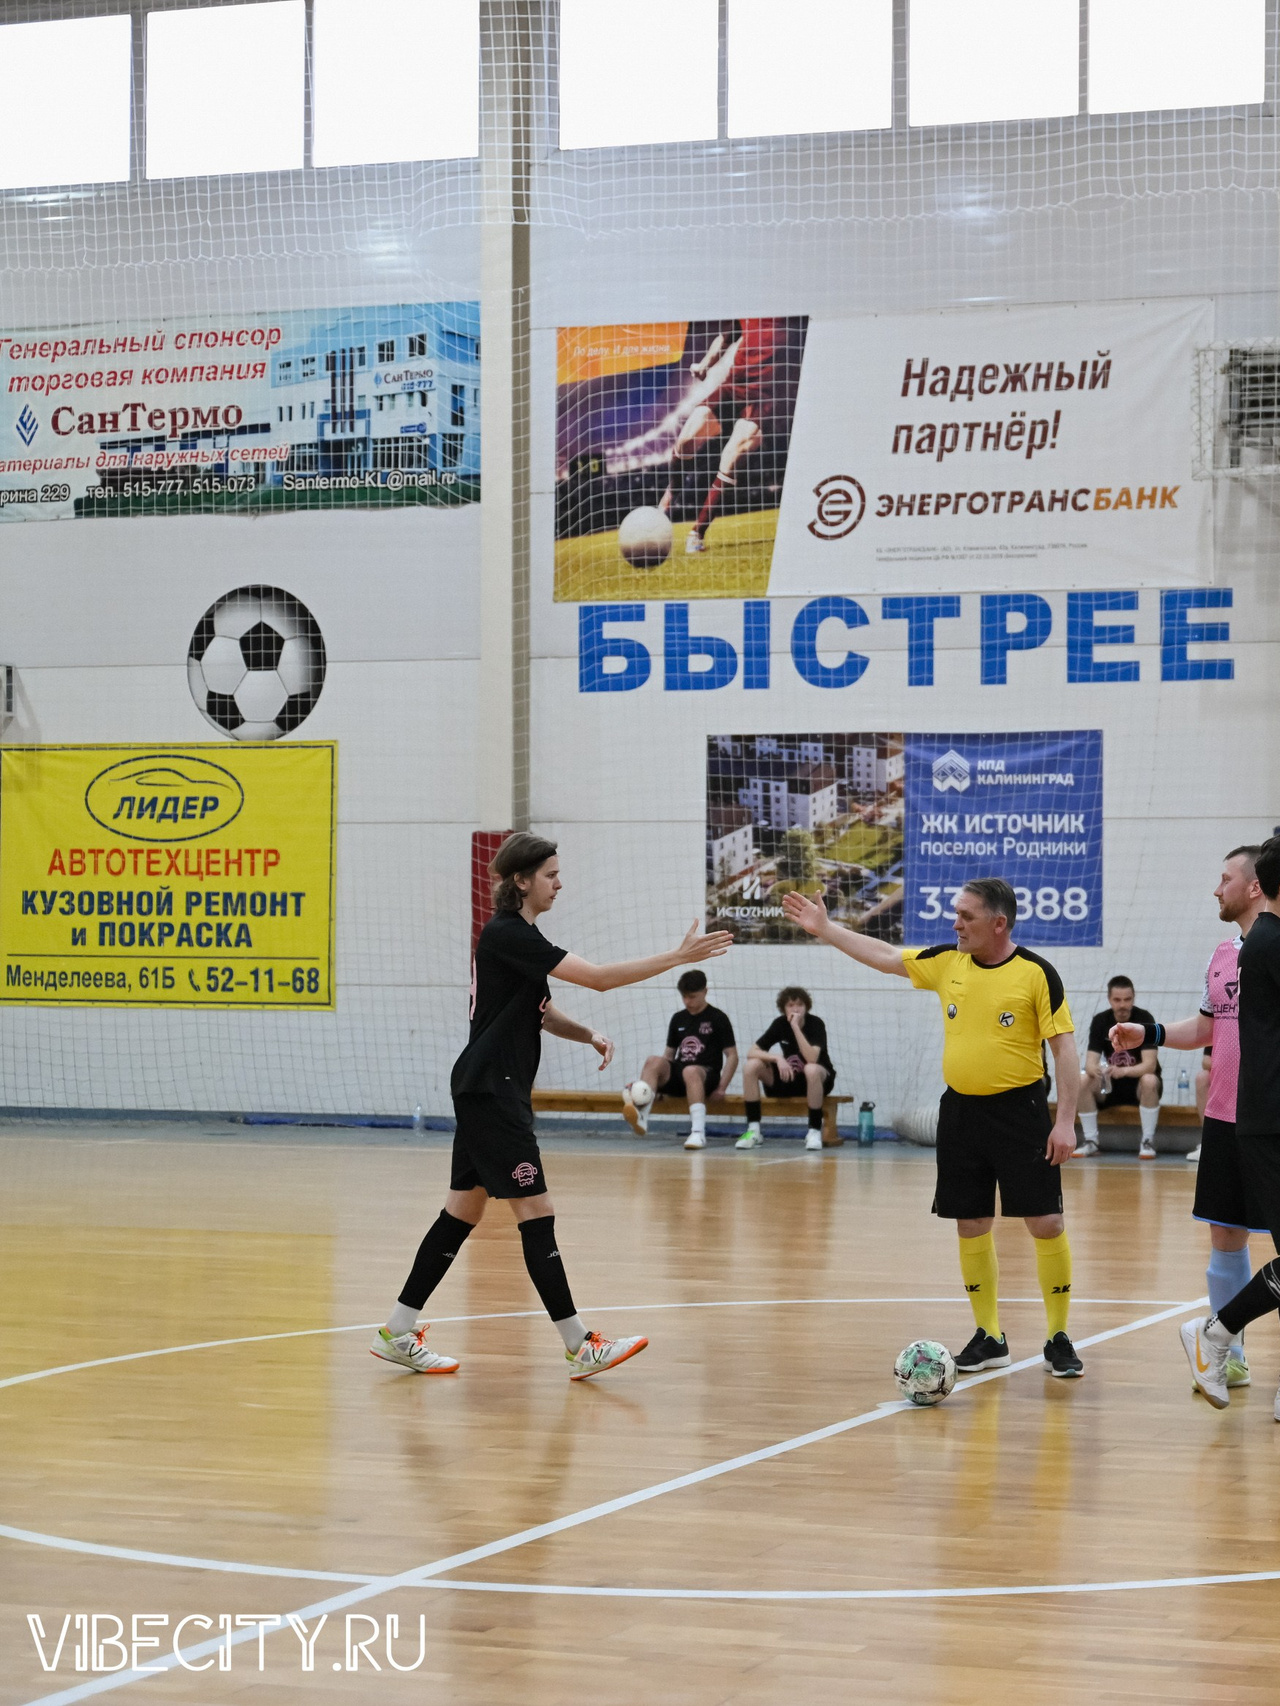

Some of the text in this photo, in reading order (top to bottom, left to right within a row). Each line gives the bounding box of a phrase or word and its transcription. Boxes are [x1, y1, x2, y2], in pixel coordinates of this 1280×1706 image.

[0, 326, 281, 363] Генеральный спонсор
[8, 360, 266, 396] торговая компания
[901, 350, 1112, 402] Надежный
[51, 402, 243, 438] СанТермо
[892, 409, 1062, 462] партнёр!
[95, 451, 128, 470] для
[132, 448, 225, 470] наружных
[229, 443, 289, 463] сетей
[40, 484, 70, 502] 229
[86, 485, 118, 499] тел.
[192, 476, 255, 493] 515-073
[875, 485, 1181, 517] ЭНЕРГОТРАНСБАНК
[578, 587, 1236, 693] БЫСТРЕЕ
[977, 760, 1005, 772] КПД
[977, 773, 1074, 786] КАЛИНИНГРАД
[113, 796, 219, 824] ЛИДЕР
[921, 813, 1085, 834] ЖК ИСТОЧНИК
[920, 837, 1087, 858] поселок Родники
[47, 848, 281, 881] АВТОТЕХЦЕНТР
[21, 885, 305, 917] КУЗОВНОЙ РЕМОНТ
[98, 922, 252, 948] ПОКРАСКА
[6, 964, 132, 991] Менделеева,
[206, 967, 320, 993] 52-11-68
